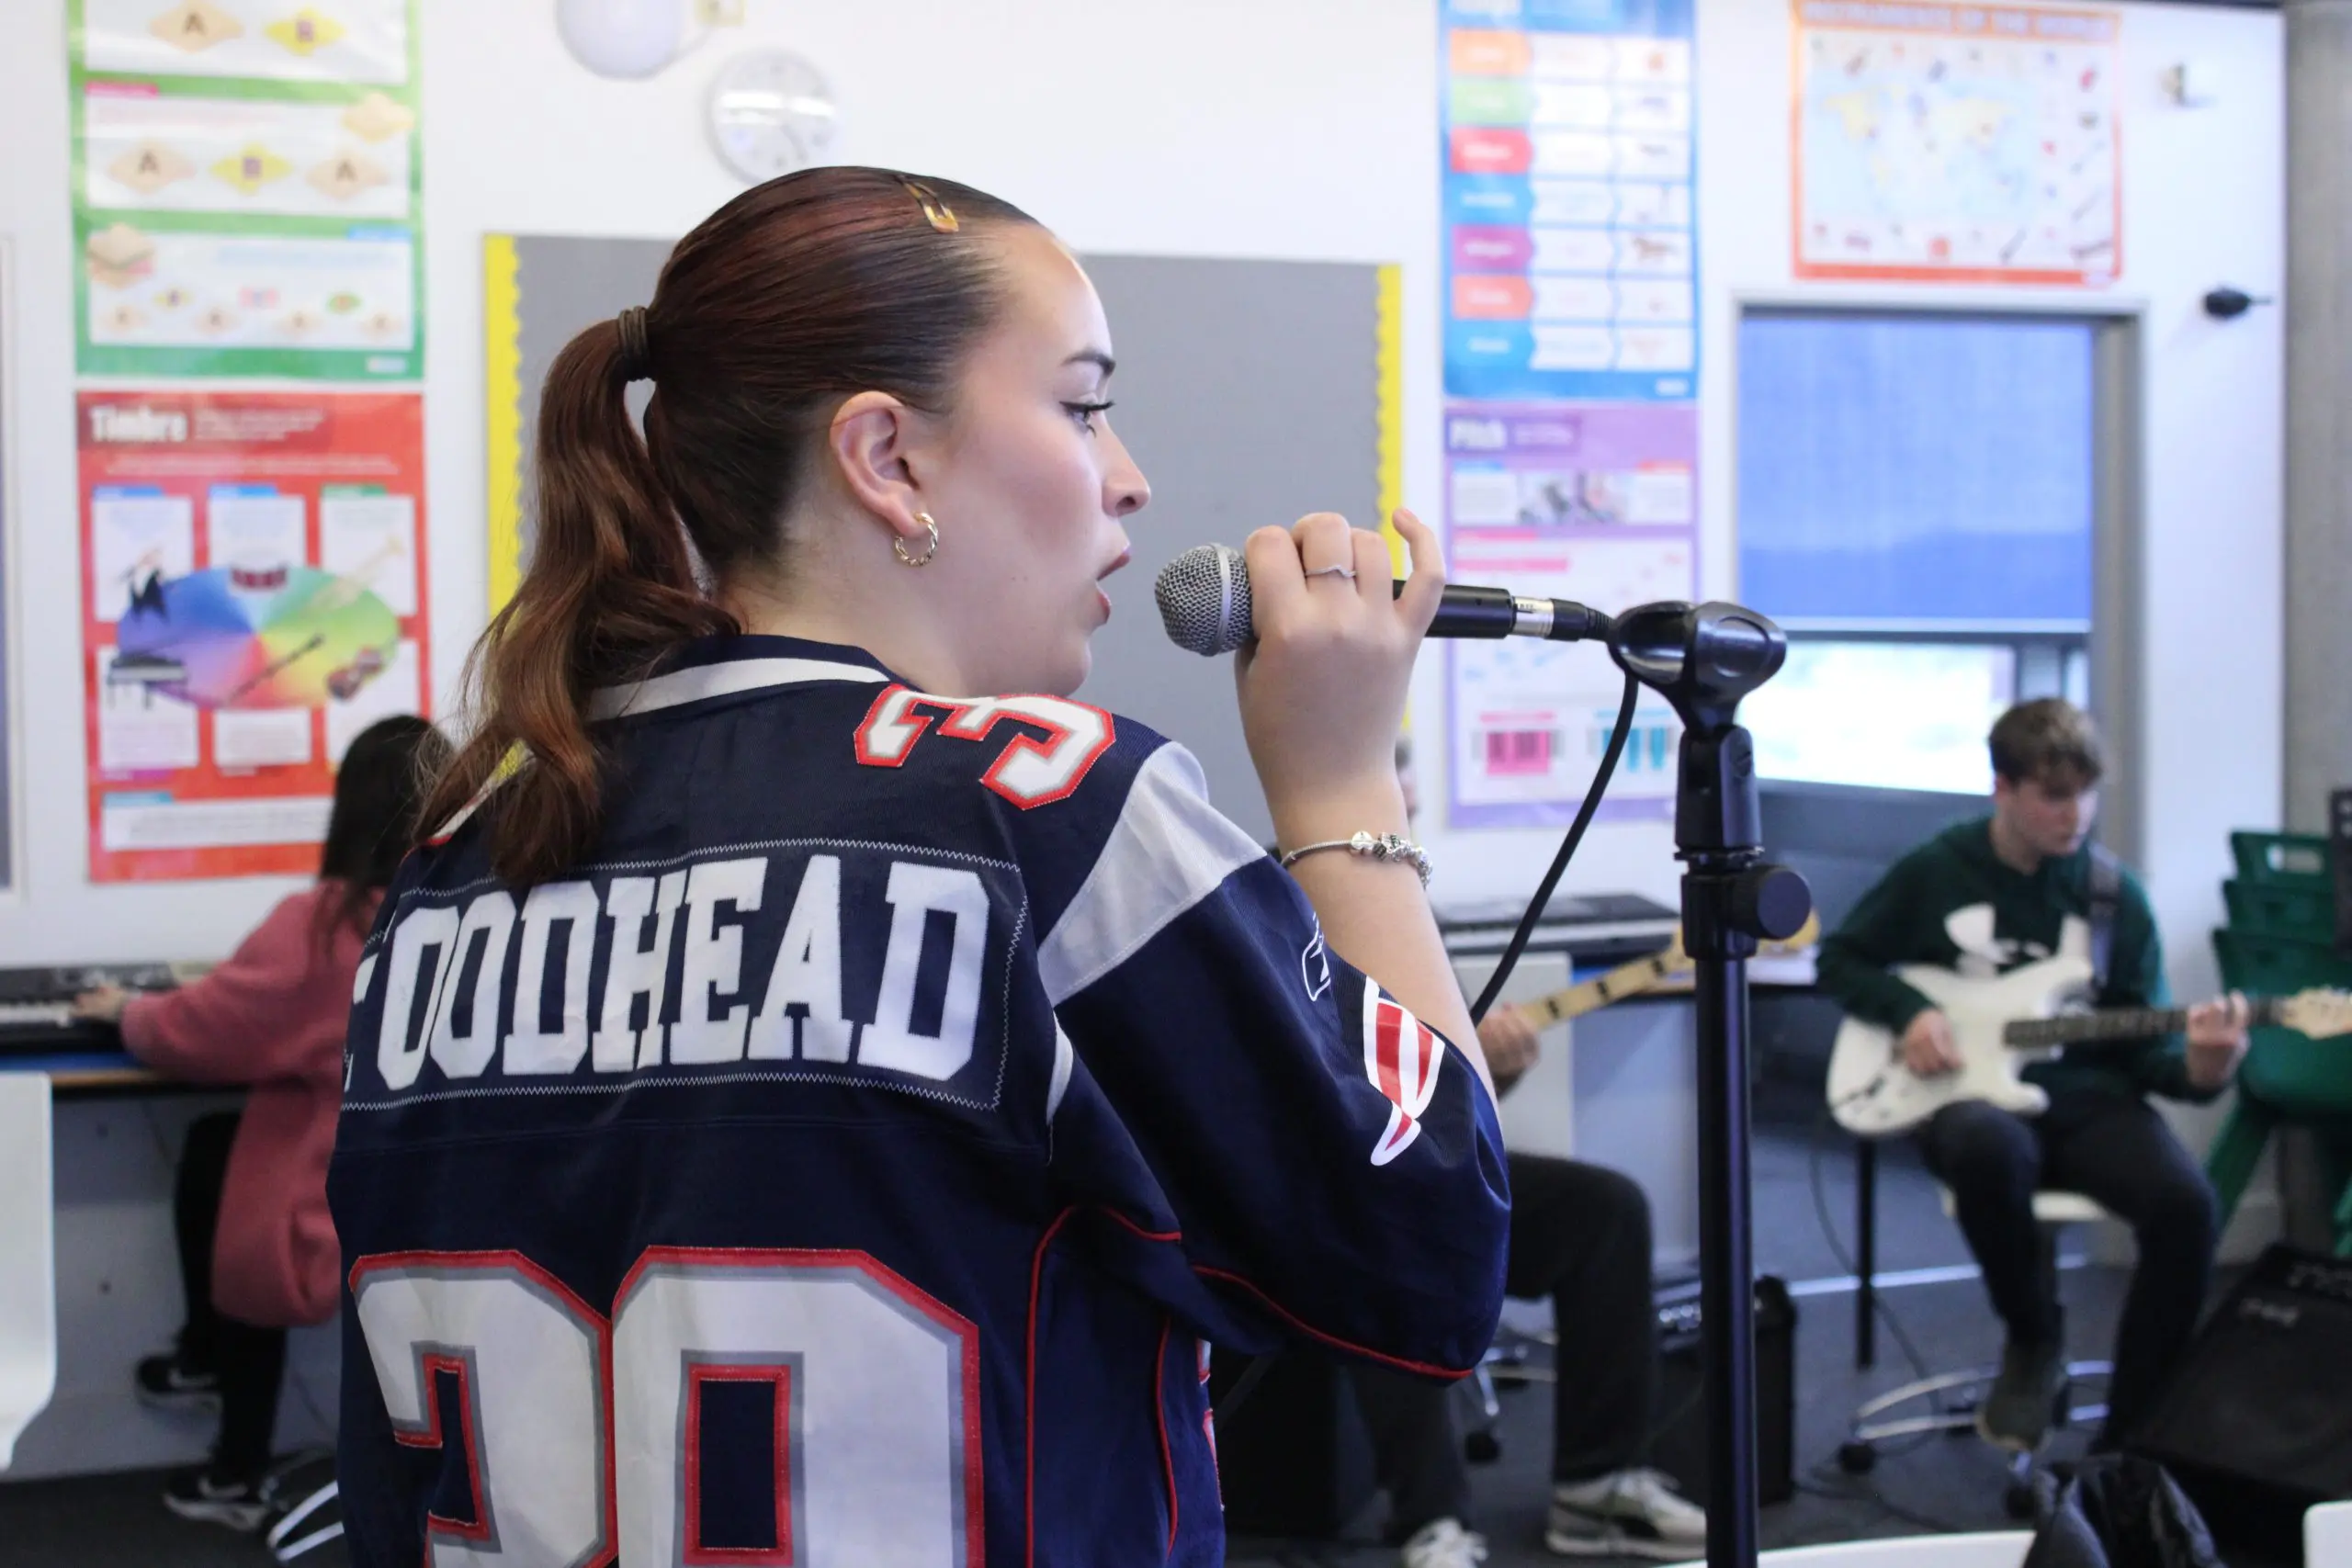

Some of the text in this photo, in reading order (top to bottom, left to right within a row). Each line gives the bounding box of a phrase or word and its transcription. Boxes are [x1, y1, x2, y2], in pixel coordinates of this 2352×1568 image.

[184, 13, 206, 36] A
[854, 682, 1116, 810] 3
[345, 854, 990, 1093] OODHEAD
